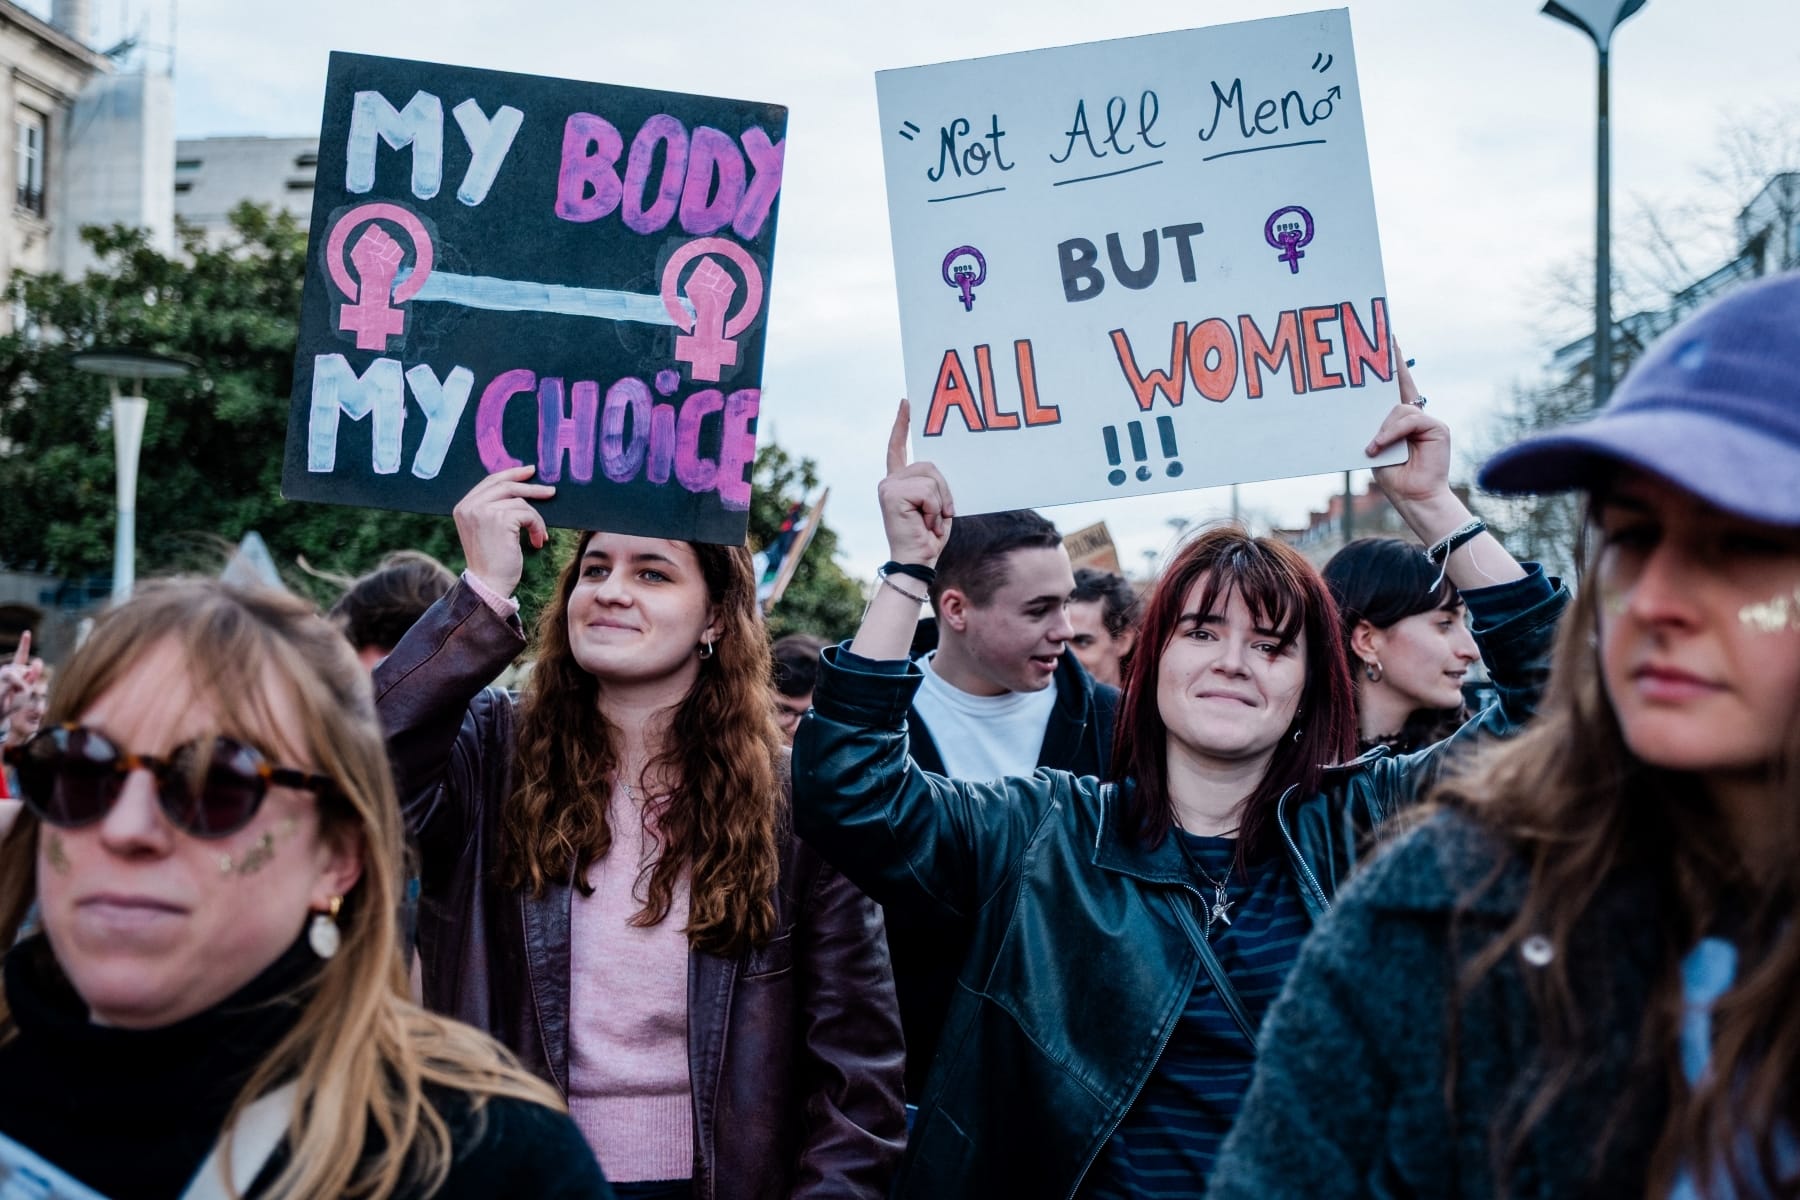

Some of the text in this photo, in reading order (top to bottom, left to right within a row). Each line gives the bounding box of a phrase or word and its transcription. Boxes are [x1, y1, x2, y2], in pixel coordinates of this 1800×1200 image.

[346, 90, 785, 240] MY BODY
[1049, 90, 1166, 164] All
[1057, 222, 1204, 302] BUT
[307, 352, 474, 480] MY
[923, 297, 1393, 437] ALL WOMEN
[1102, 415, 1184, 487] !!!
